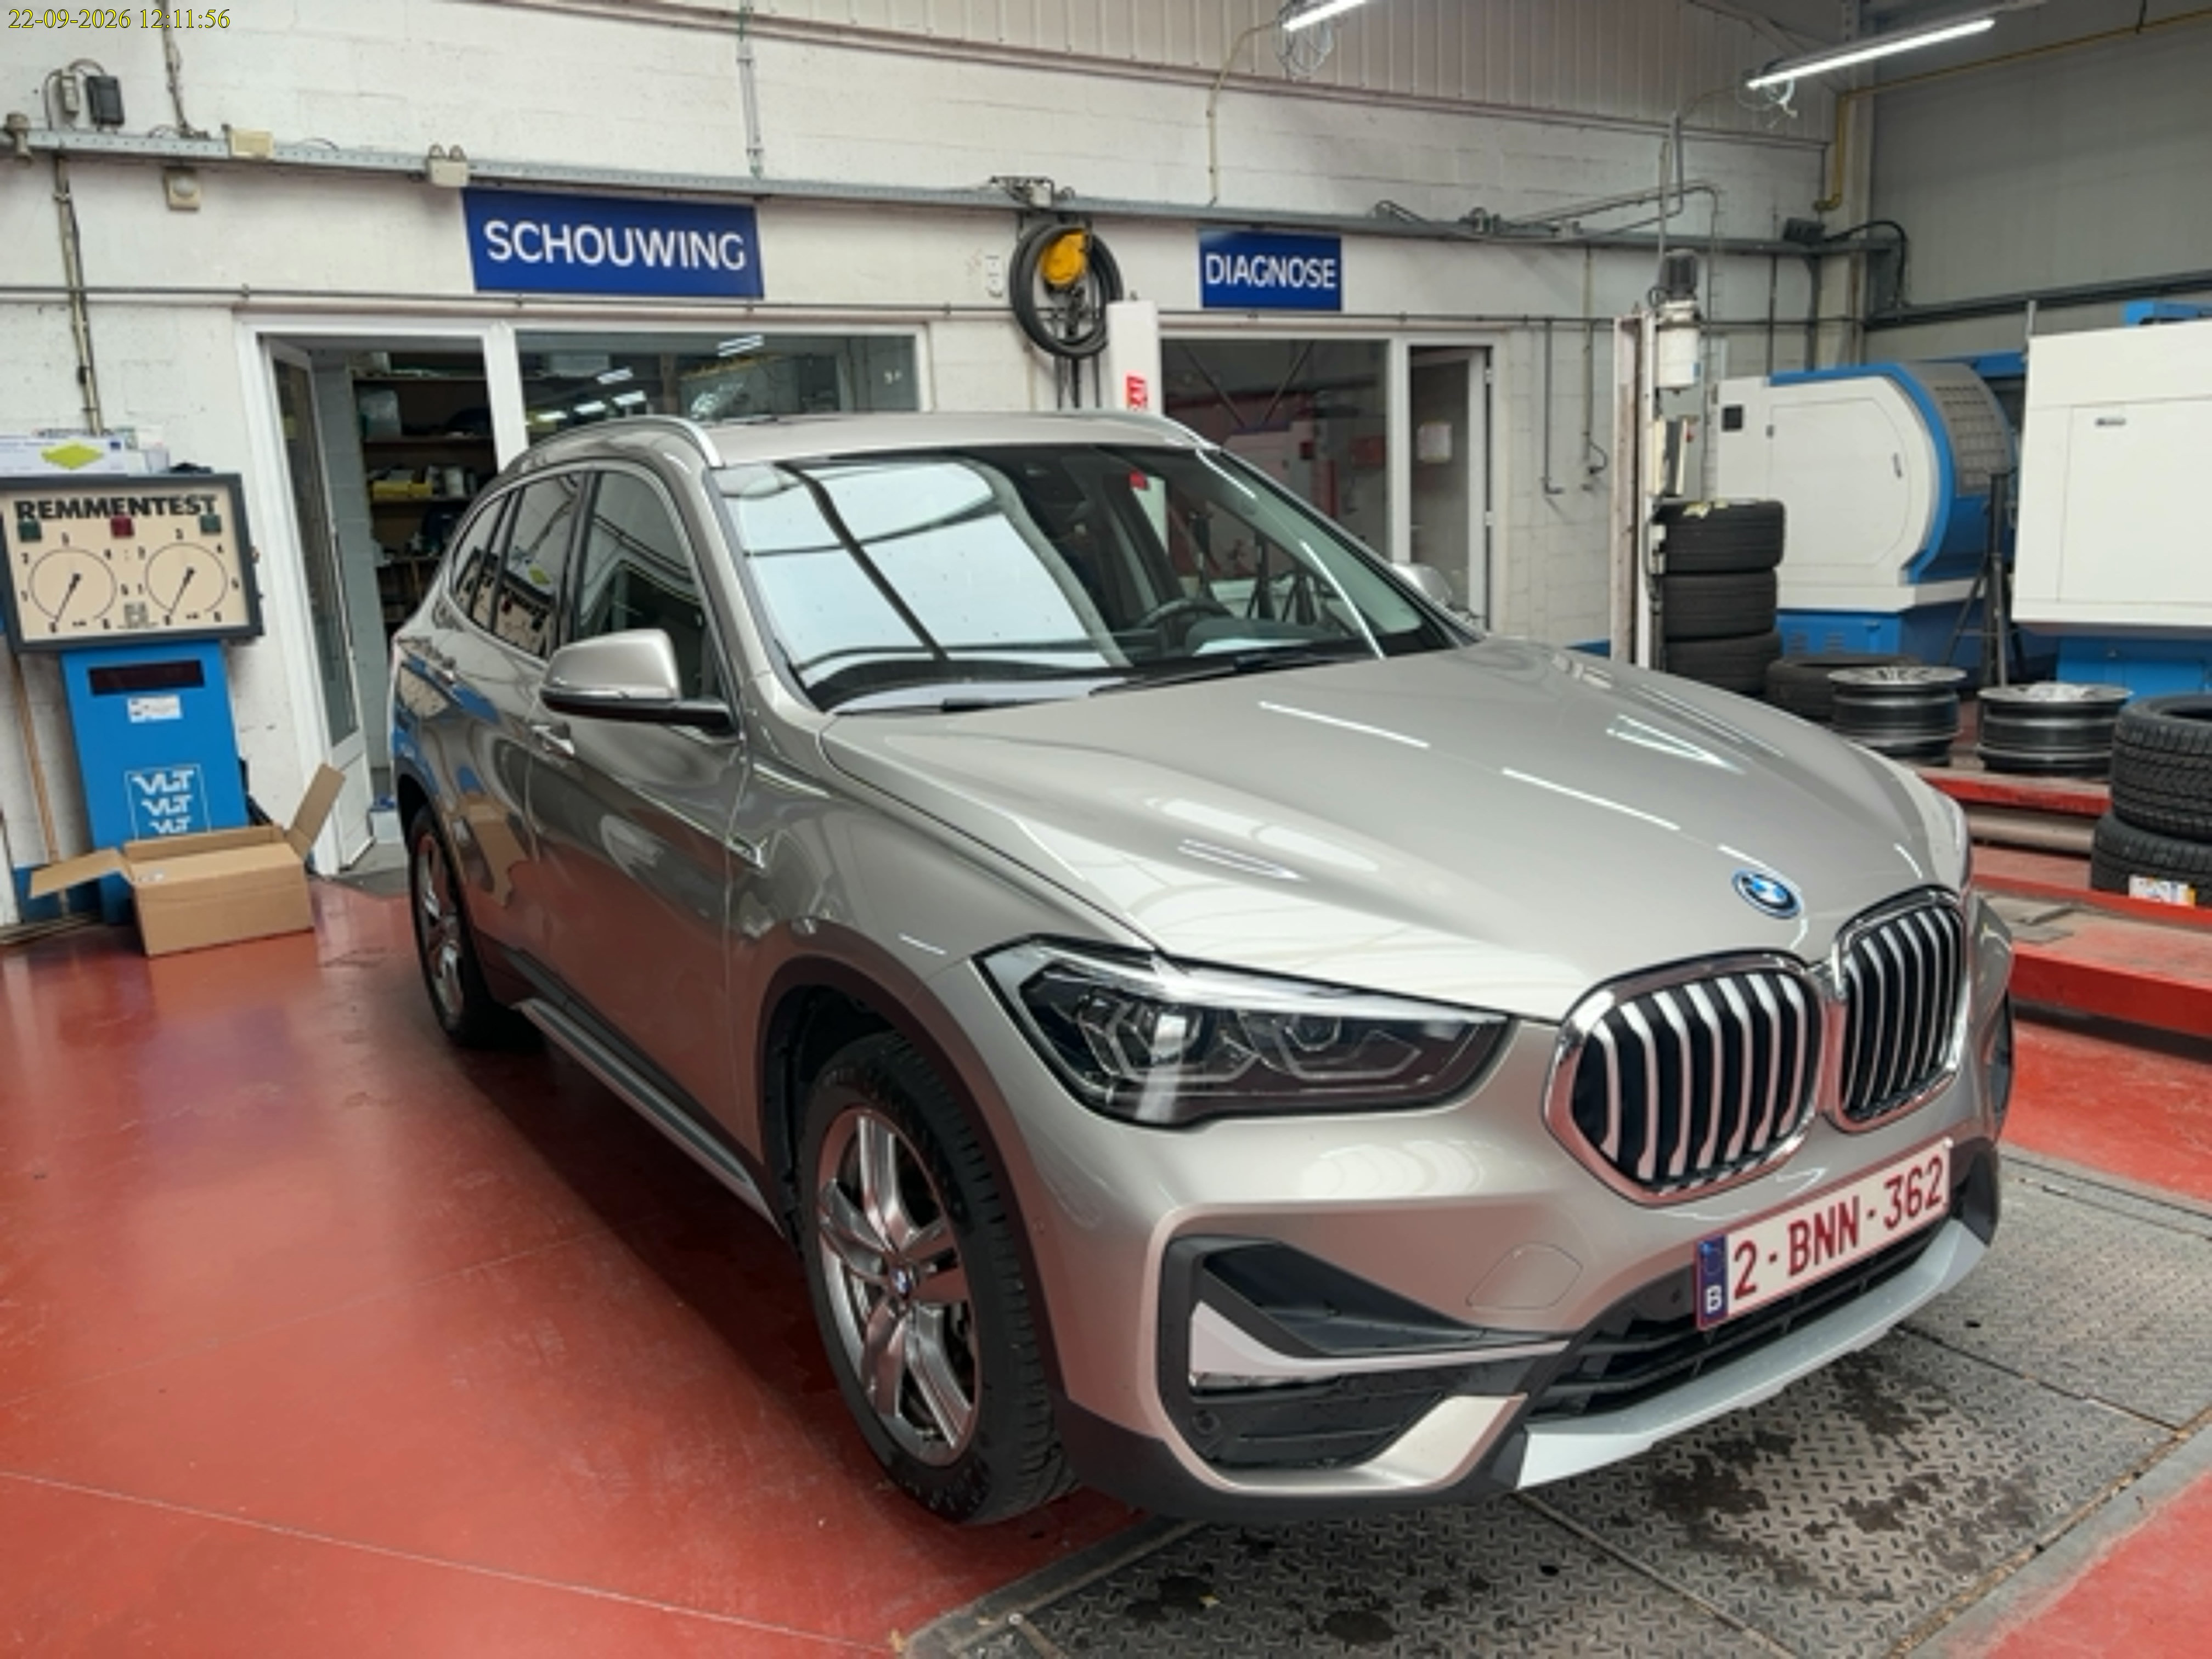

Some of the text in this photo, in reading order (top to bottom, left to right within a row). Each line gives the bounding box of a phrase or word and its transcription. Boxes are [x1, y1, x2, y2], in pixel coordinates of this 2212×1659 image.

[483, 221, 746, 271] SCHOUWING
[1205, 254, 1336, 289] DIAGNOSE
[14, 495, 217, 518] REMMENTEST
[1706, 1284, 1722, 1314] B
